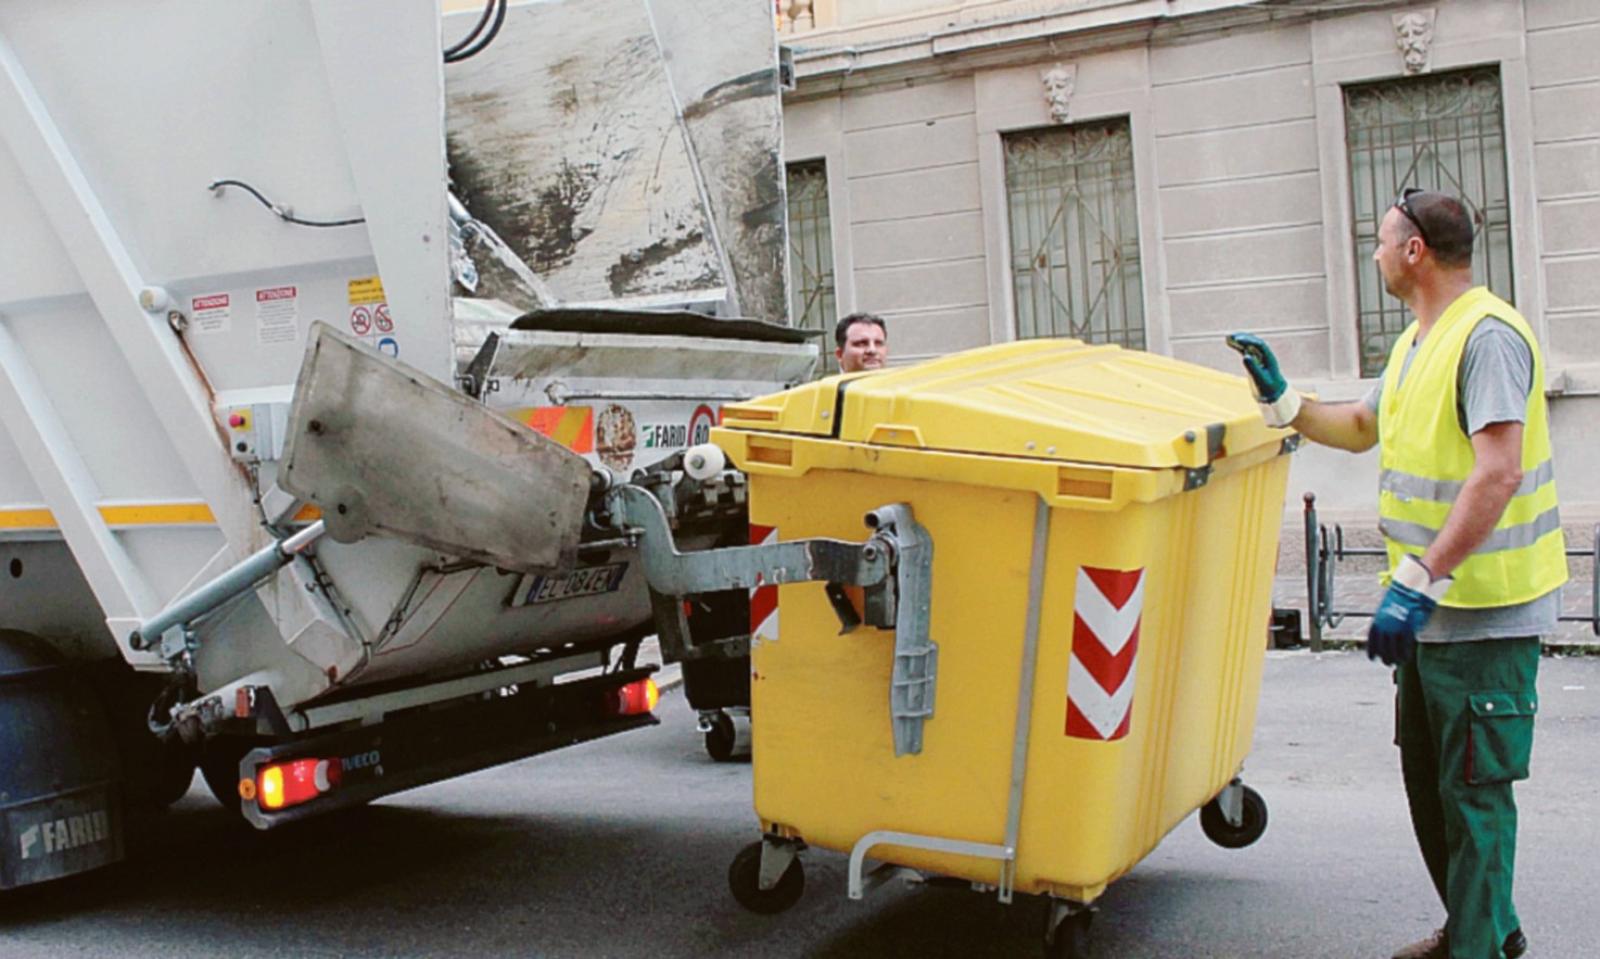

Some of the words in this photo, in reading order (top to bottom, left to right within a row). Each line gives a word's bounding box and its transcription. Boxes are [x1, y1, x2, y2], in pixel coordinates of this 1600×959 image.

[655, 424, 687, 448] FARID
[340, 750, 381, 771] IVECO
[41, 811, 110, 854] FARID
